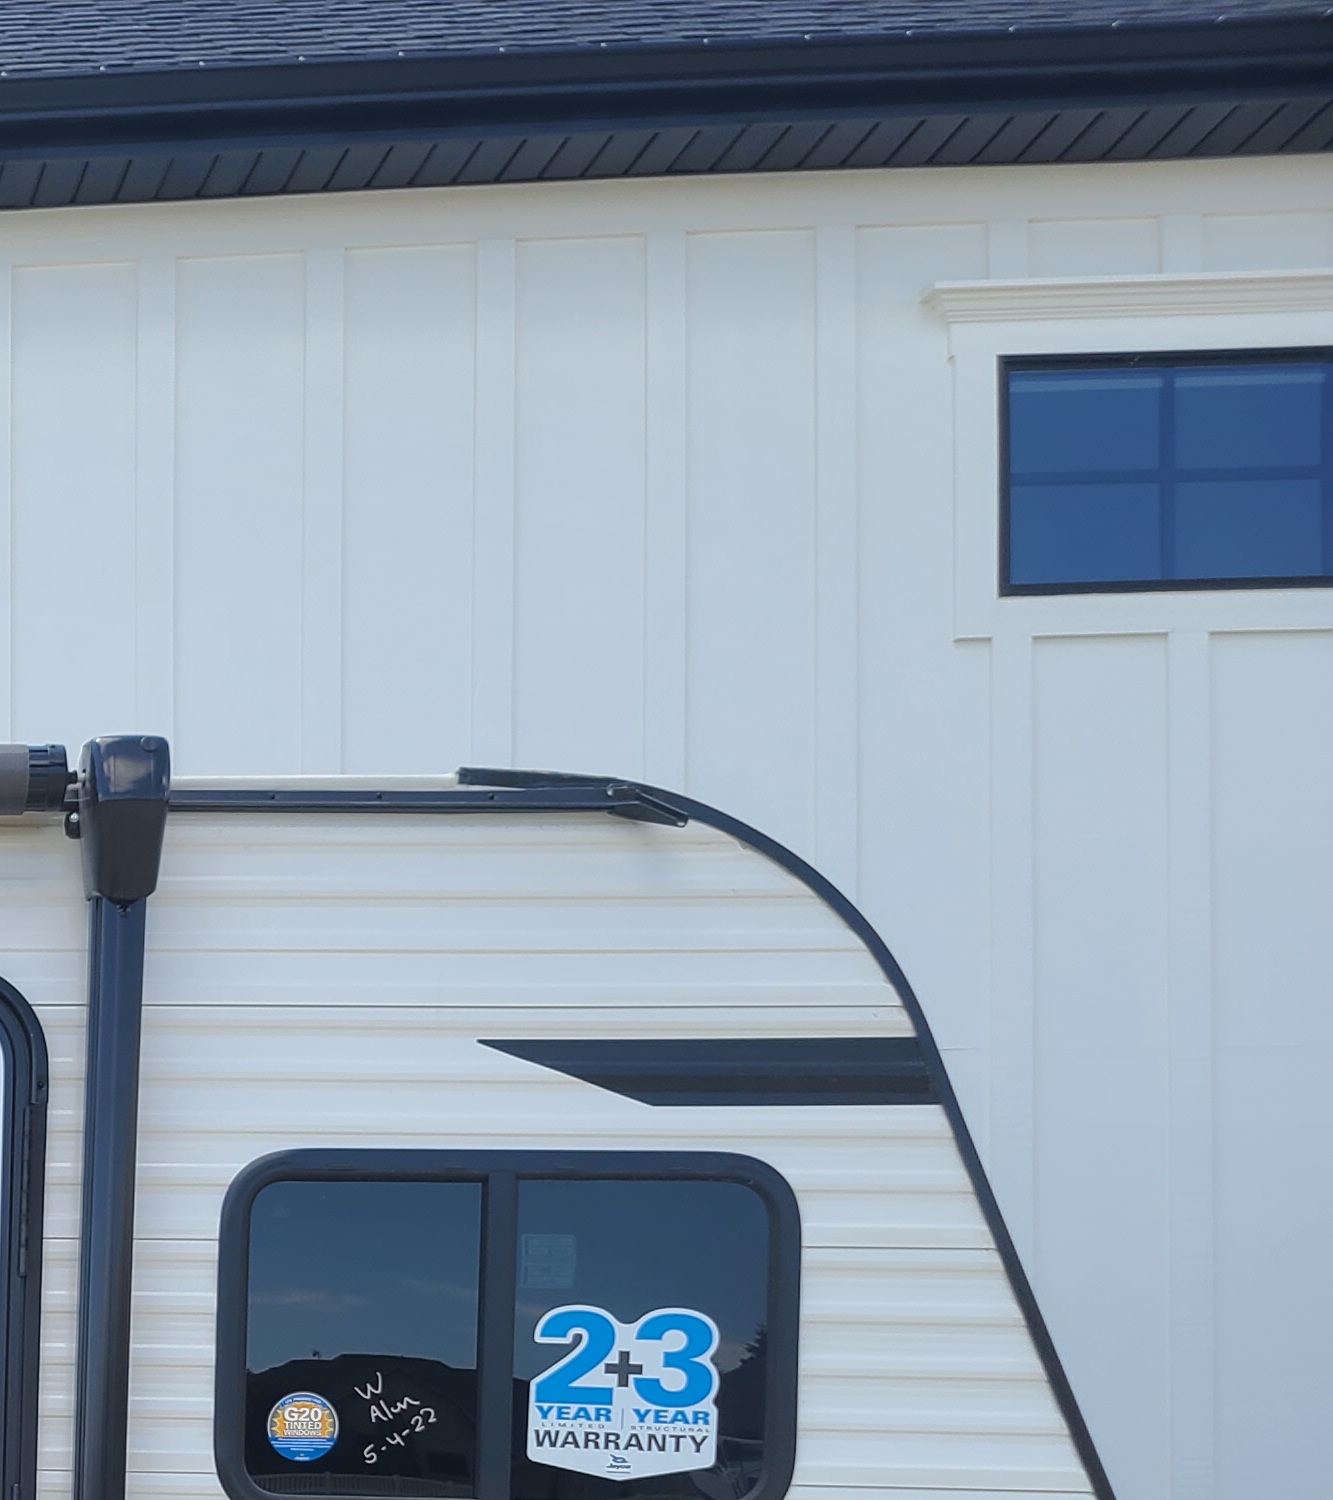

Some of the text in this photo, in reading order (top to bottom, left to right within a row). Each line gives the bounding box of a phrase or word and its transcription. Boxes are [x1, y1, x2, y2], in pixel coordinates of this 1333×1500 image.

[284, 1407, 322, 1421] G20
[535, 1405, 710, 1425] YEAR YEAR
[284, 1421, 322, 1430] TINTED
[631, 1425, 710, 1433] STRUCTURAL
[534, 1429, 709, 1453] WARRANTY
